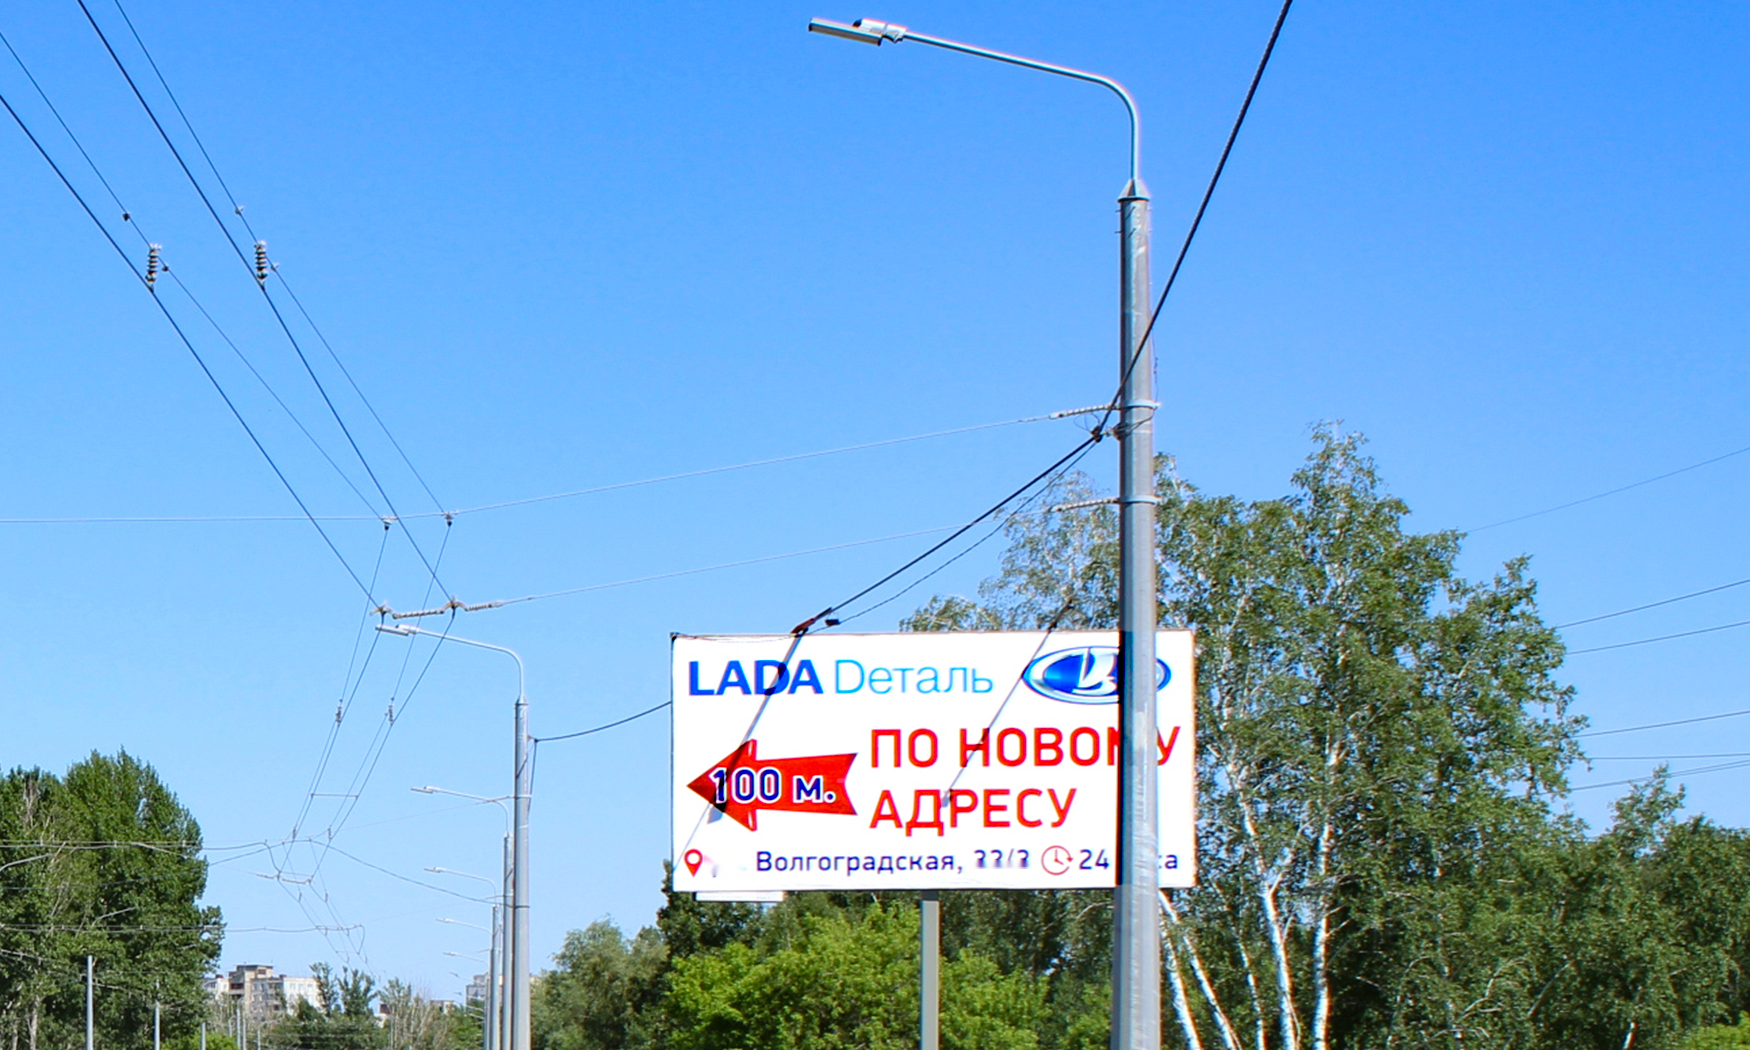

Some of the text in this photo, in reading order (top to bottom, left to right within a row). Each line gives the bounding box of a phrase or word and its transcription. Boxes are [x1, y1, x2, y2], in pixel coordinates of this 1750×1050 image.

[688, 659, 824, 696] LADA
[870, 728, 939, 768] ПО
[709, 767, 782, 804] 100
[869, 787, 1078, 837] АДРЕСУ
[756, 850, 963, 877] Волгоградская,
[1079, 848, 1110, 870] 24
